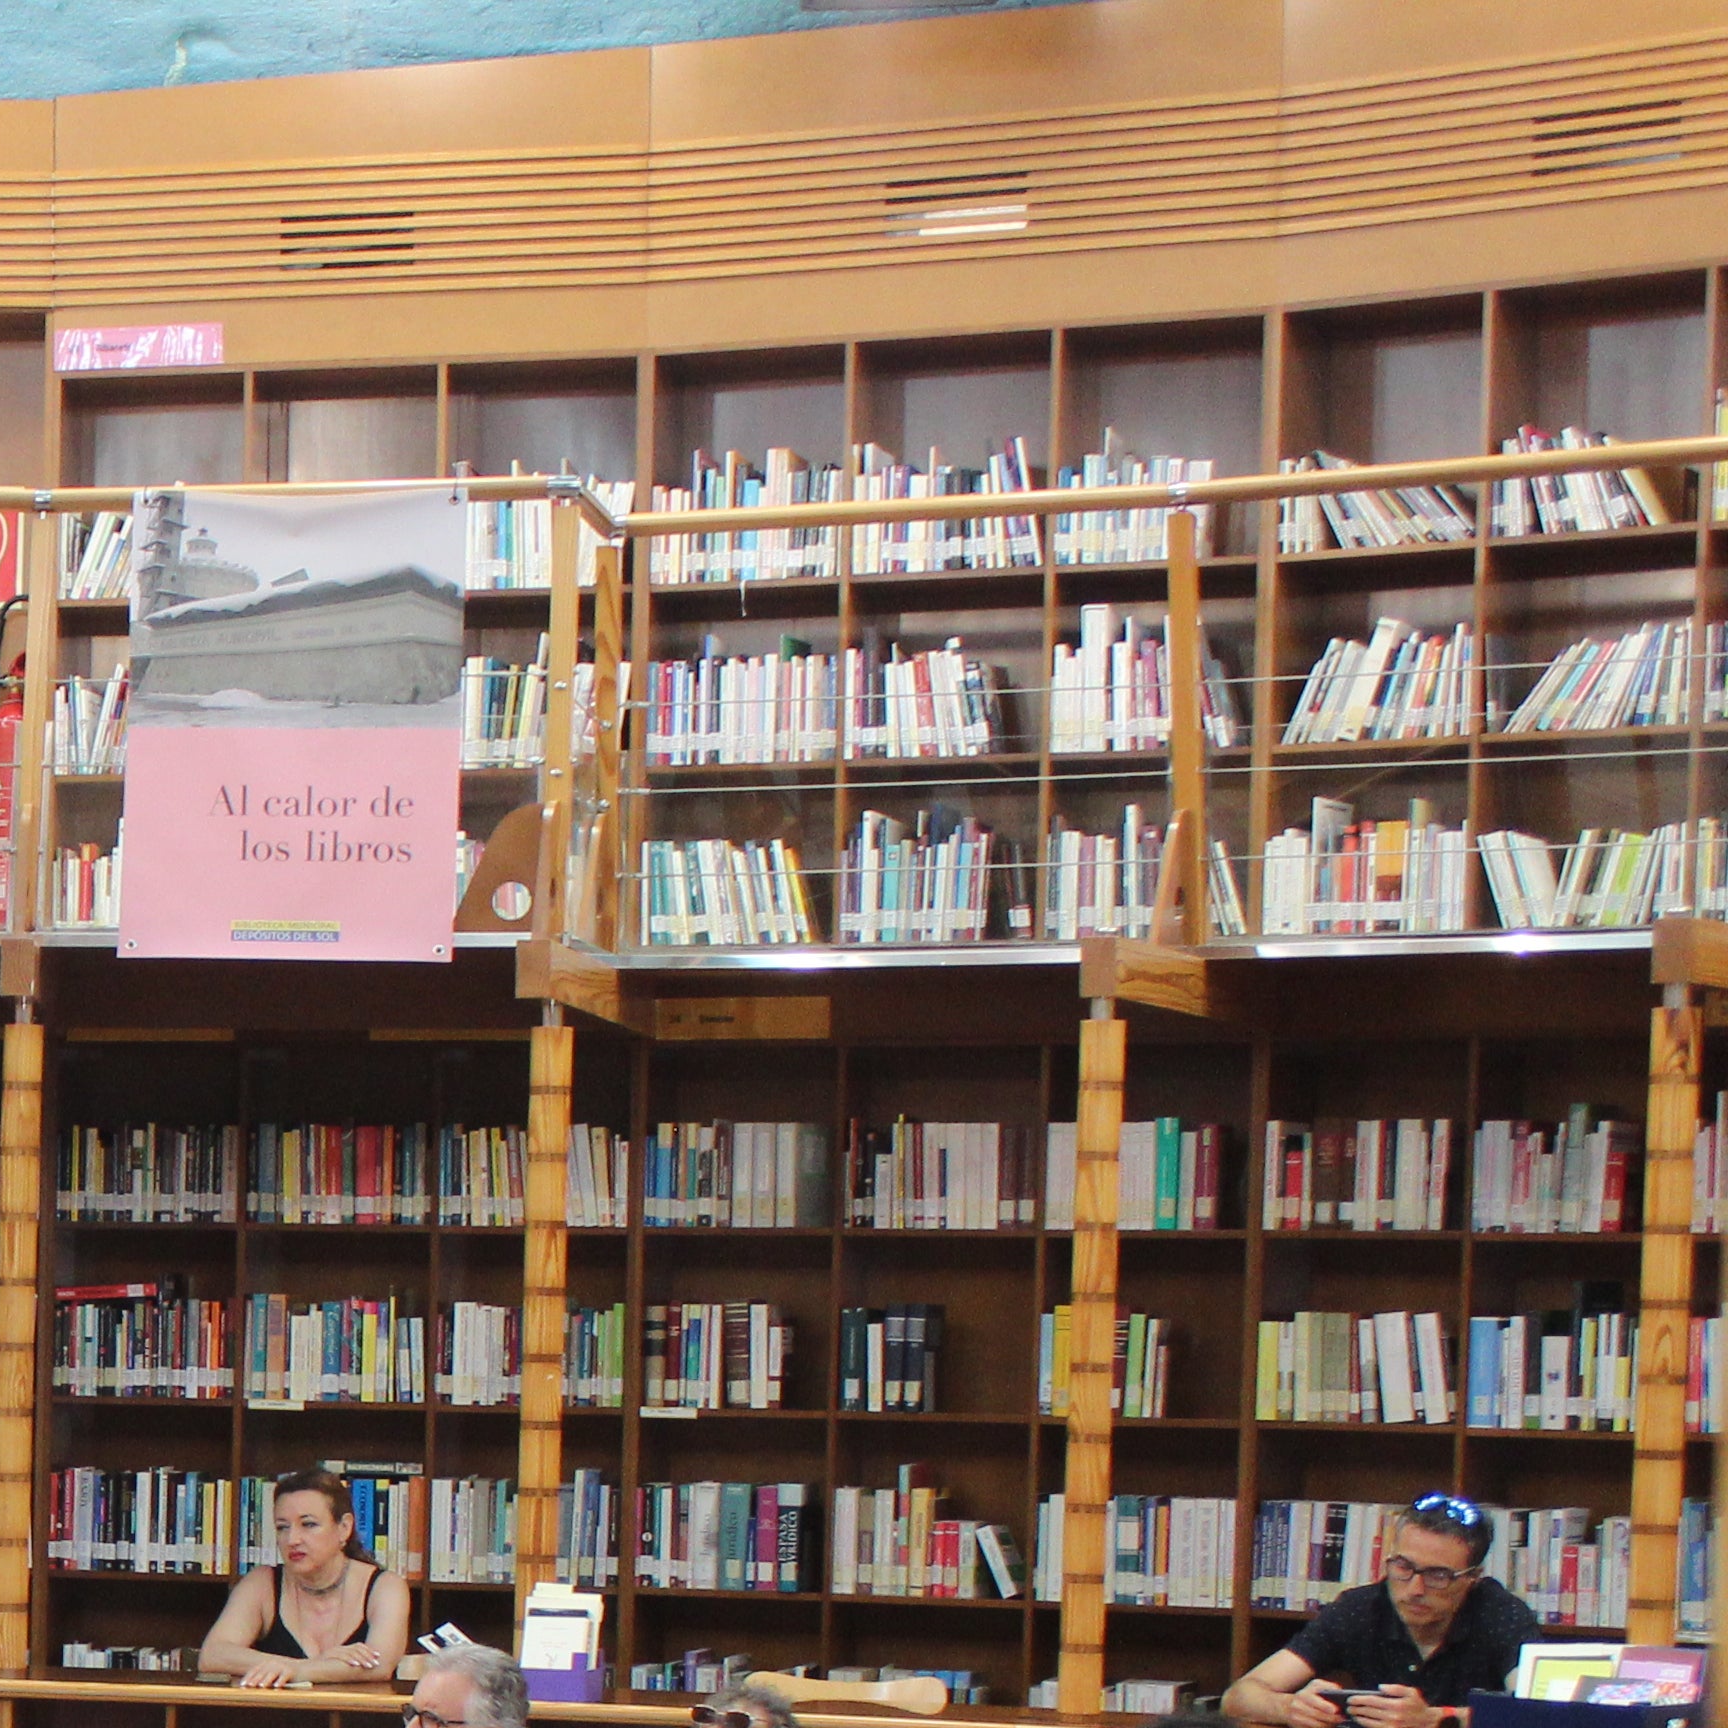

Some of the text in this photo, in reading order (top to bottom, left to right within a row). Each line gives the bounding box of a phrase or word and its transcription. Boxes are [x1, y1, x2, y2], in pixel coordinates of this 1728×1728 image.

[208, 784, 414, 818] Al calor de
[240, 829, 414, 863] los libros
[233, 930, 337, 943] DEPÓSITOS DEL SOL
[778, 1511, 788, 1562] ESPASA
